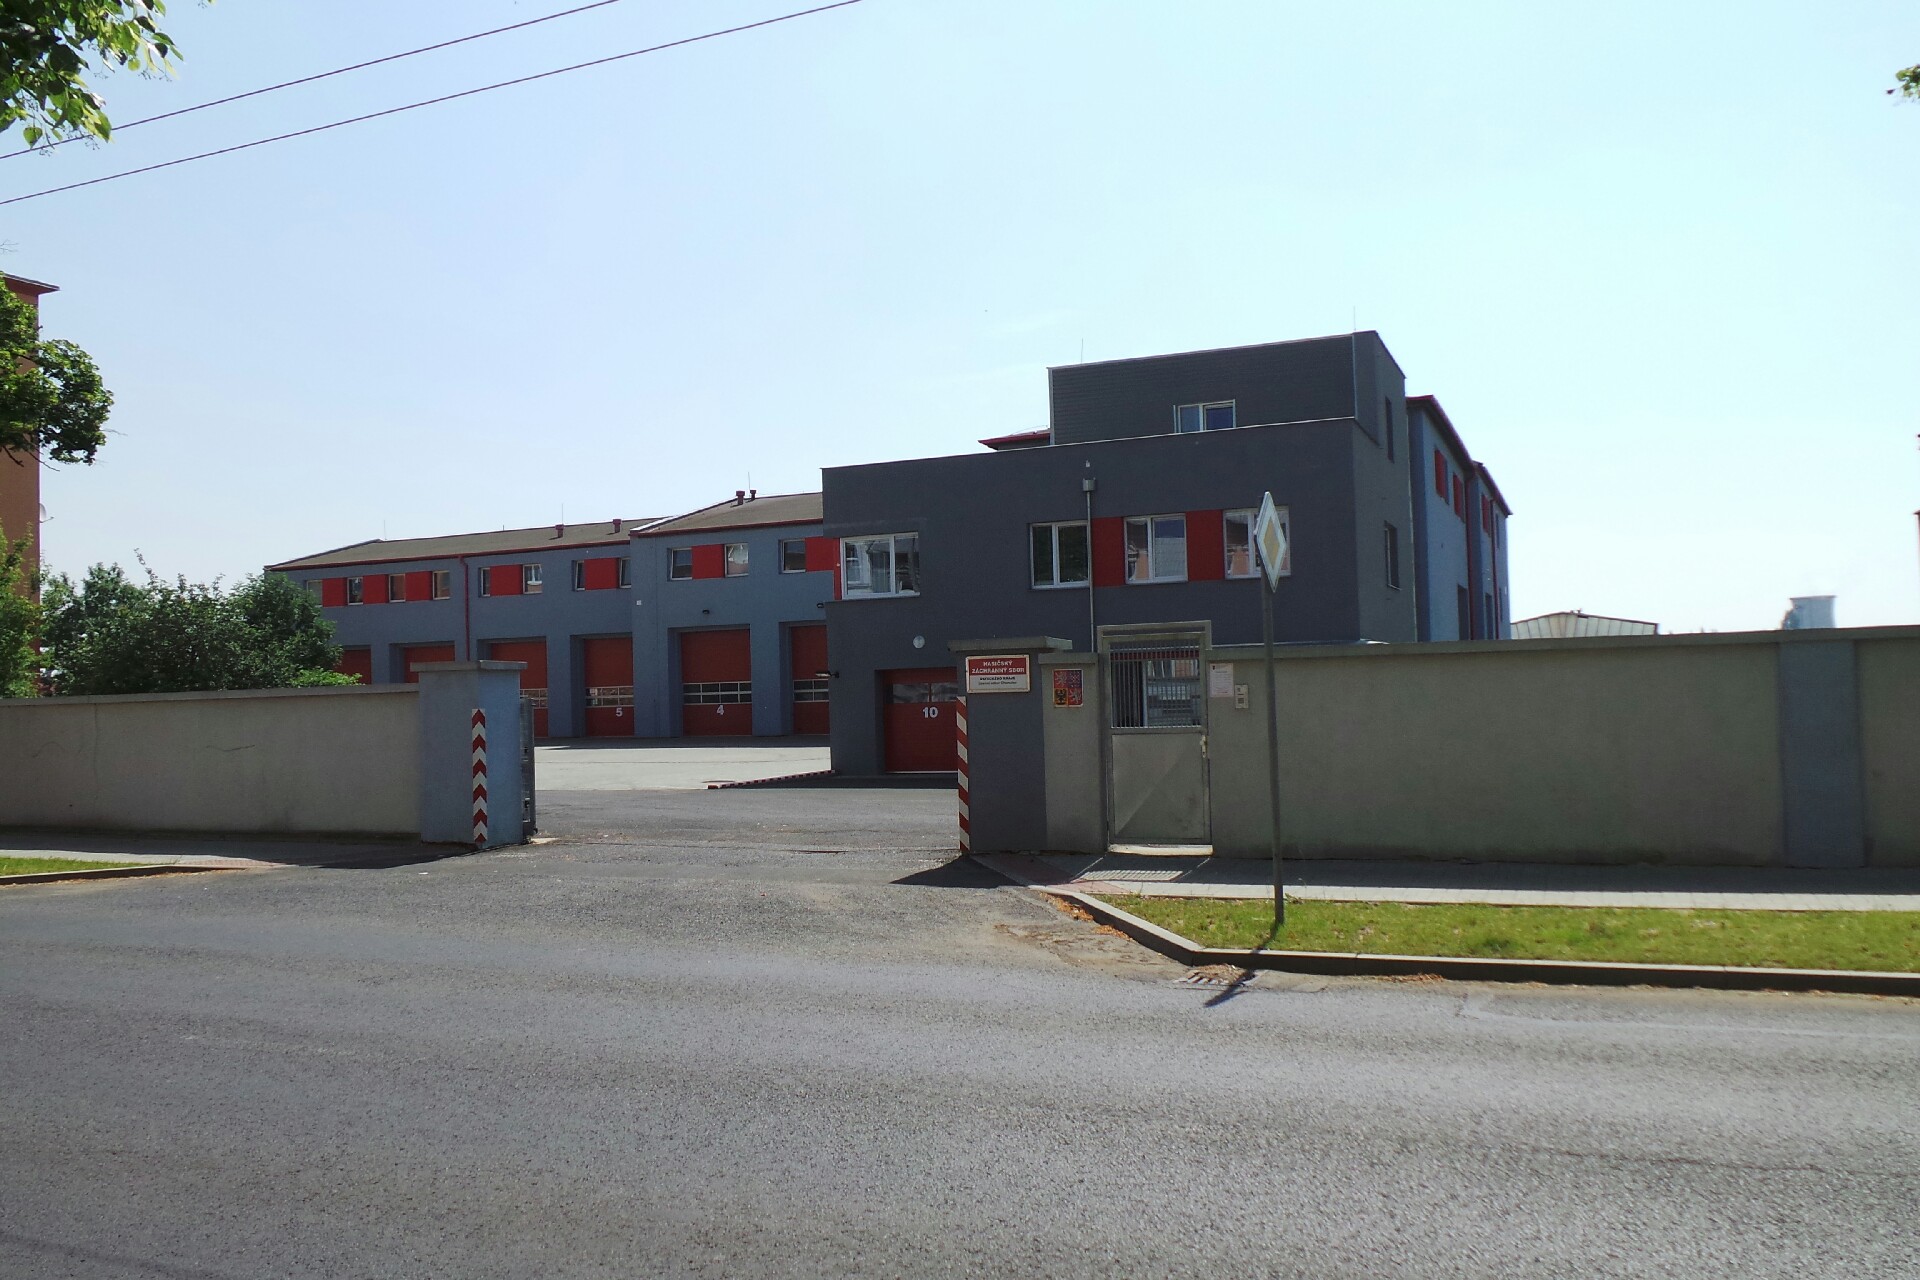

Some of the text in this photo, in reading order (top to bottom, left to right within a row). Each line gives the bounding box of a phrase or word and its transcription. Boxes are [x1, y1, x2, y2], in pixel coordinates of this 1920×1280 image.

[615, 707, 623, 717] 5
[716, 704, 724, 715] 4
[922, 706, 938, 719] 10
